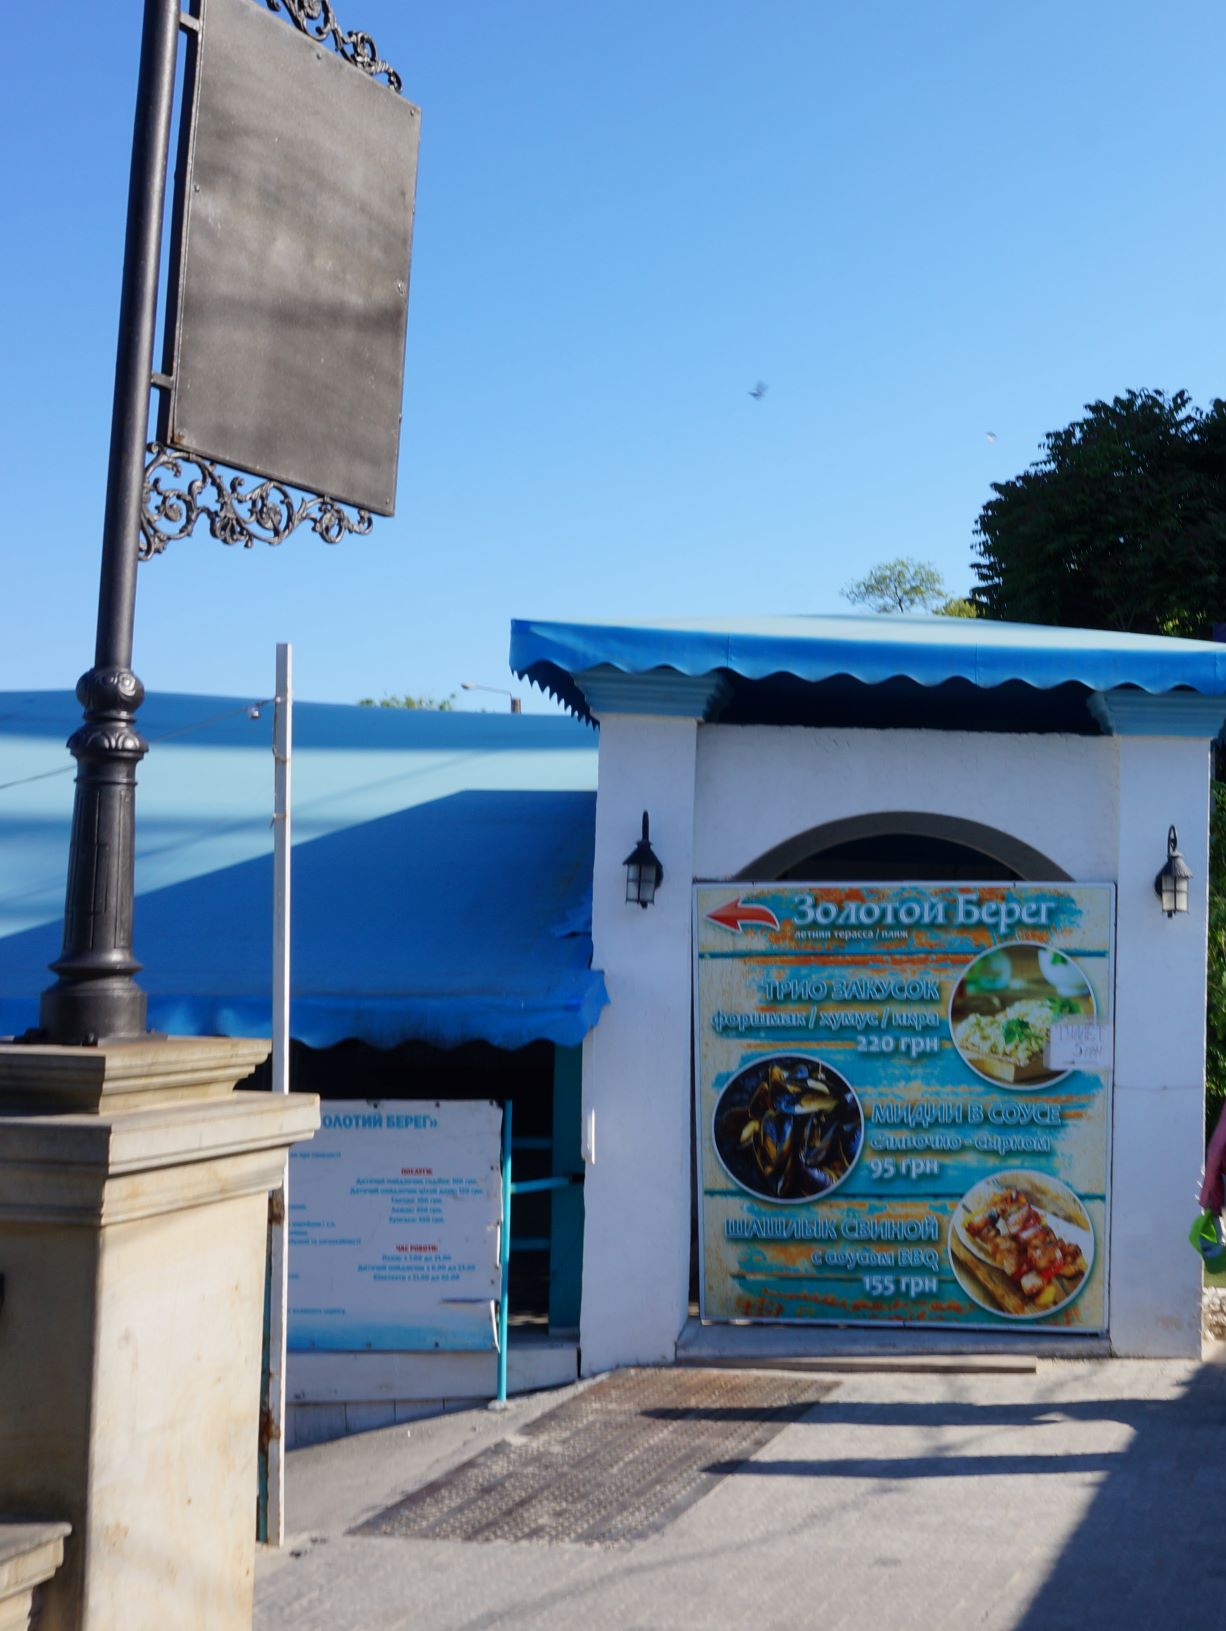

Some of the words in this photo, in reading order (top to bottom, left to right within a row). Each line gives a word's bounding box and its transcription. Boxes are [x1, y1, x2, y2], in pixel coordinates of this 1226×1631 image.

[792, 892, 950, 926] Золотой
[955, 892, 1056, 934] Берег
[833, 929, 875, 941] терасса
[881, 930, 909, 940] пляж
[764, 980, 828, 1001] ТРИО
[832, 979, 940, 1001] ЗАКУСОК
[711, 1008, 807, 1032] форшмак
[818, 1010, 880, 1031] хумус
[892, 1011, 940, 1031] икра
[857, 1036, 895, 1053] 220
[900, 1037, 939, 1058] грн
[322, 1112, 383, 1129] ОЛОТИЙ
[872, 1103, 963, 1130] МИДИИ
[966, 1104, 985, 1126] В
[987, 1103, 1063, 1127] СОУСЕ
[870, 1135, 963, 1151] сливочно
[974, 1135, 1053, 1156] сырном
[870, 1159, 895, 1180] 95
[900, 1159, 939, 1180] грн
[725, 1217, 838, 1240] ШАШЛЫК
[841, 1215, 940, 1240] СВИНОЙ
[811, 1251, 822, 1265] с
[824, 1250, 895, 1270] соусом
[897, 1248, 940, 1271] BBQ
[864, 1276, 895, 1297] 155
[899, 1277, 939, 1298] грн
